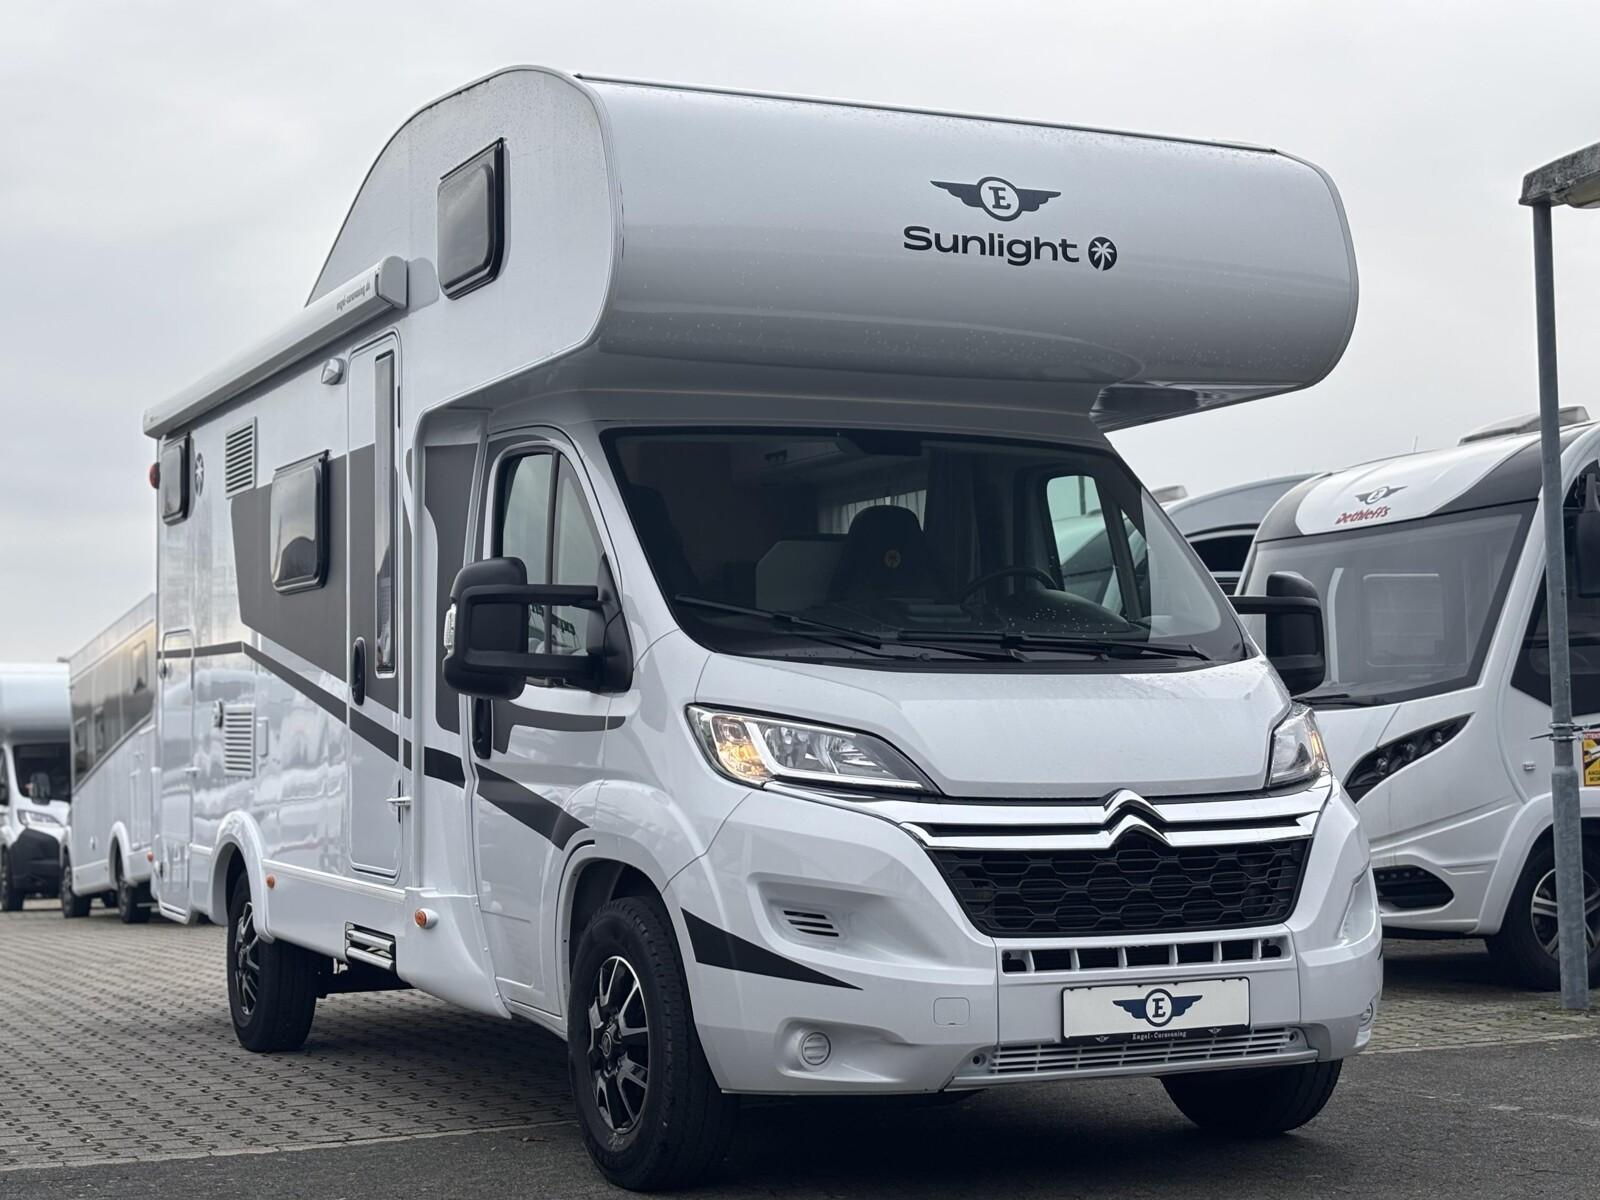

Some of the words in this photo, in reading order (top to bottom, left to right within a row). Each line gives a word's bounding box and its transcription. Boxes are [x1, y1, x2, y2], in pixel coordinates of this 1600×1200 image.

[988, 186, 1012, 210] E
[903, 225, 1080, 267] Sunlight
[1151, 997, 1166, 1018] E
